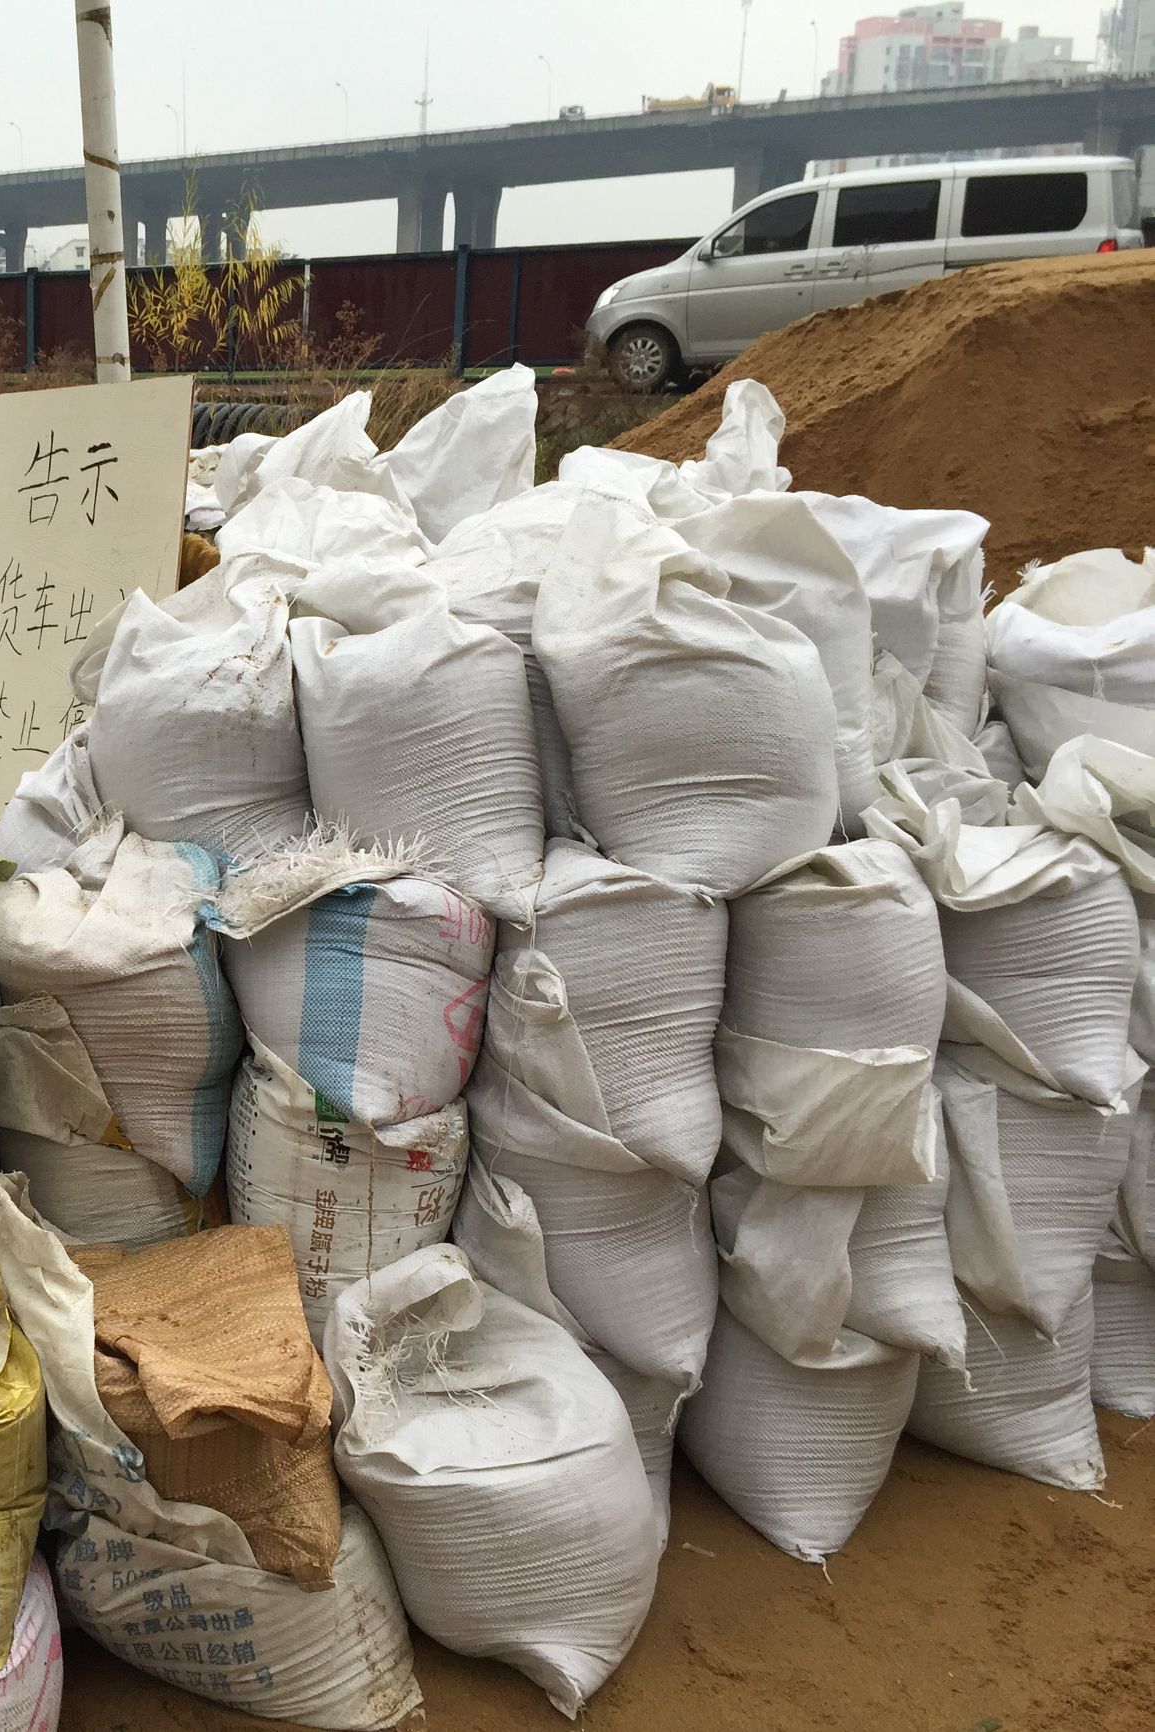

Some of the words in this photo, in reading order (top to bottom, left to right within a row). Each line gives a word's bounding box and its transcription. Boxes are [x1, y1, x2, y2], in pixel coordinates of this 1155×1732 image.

[17, 429, 119, 526] 告示
[305, 1188, 339, 1299] 金牌腻子粉
